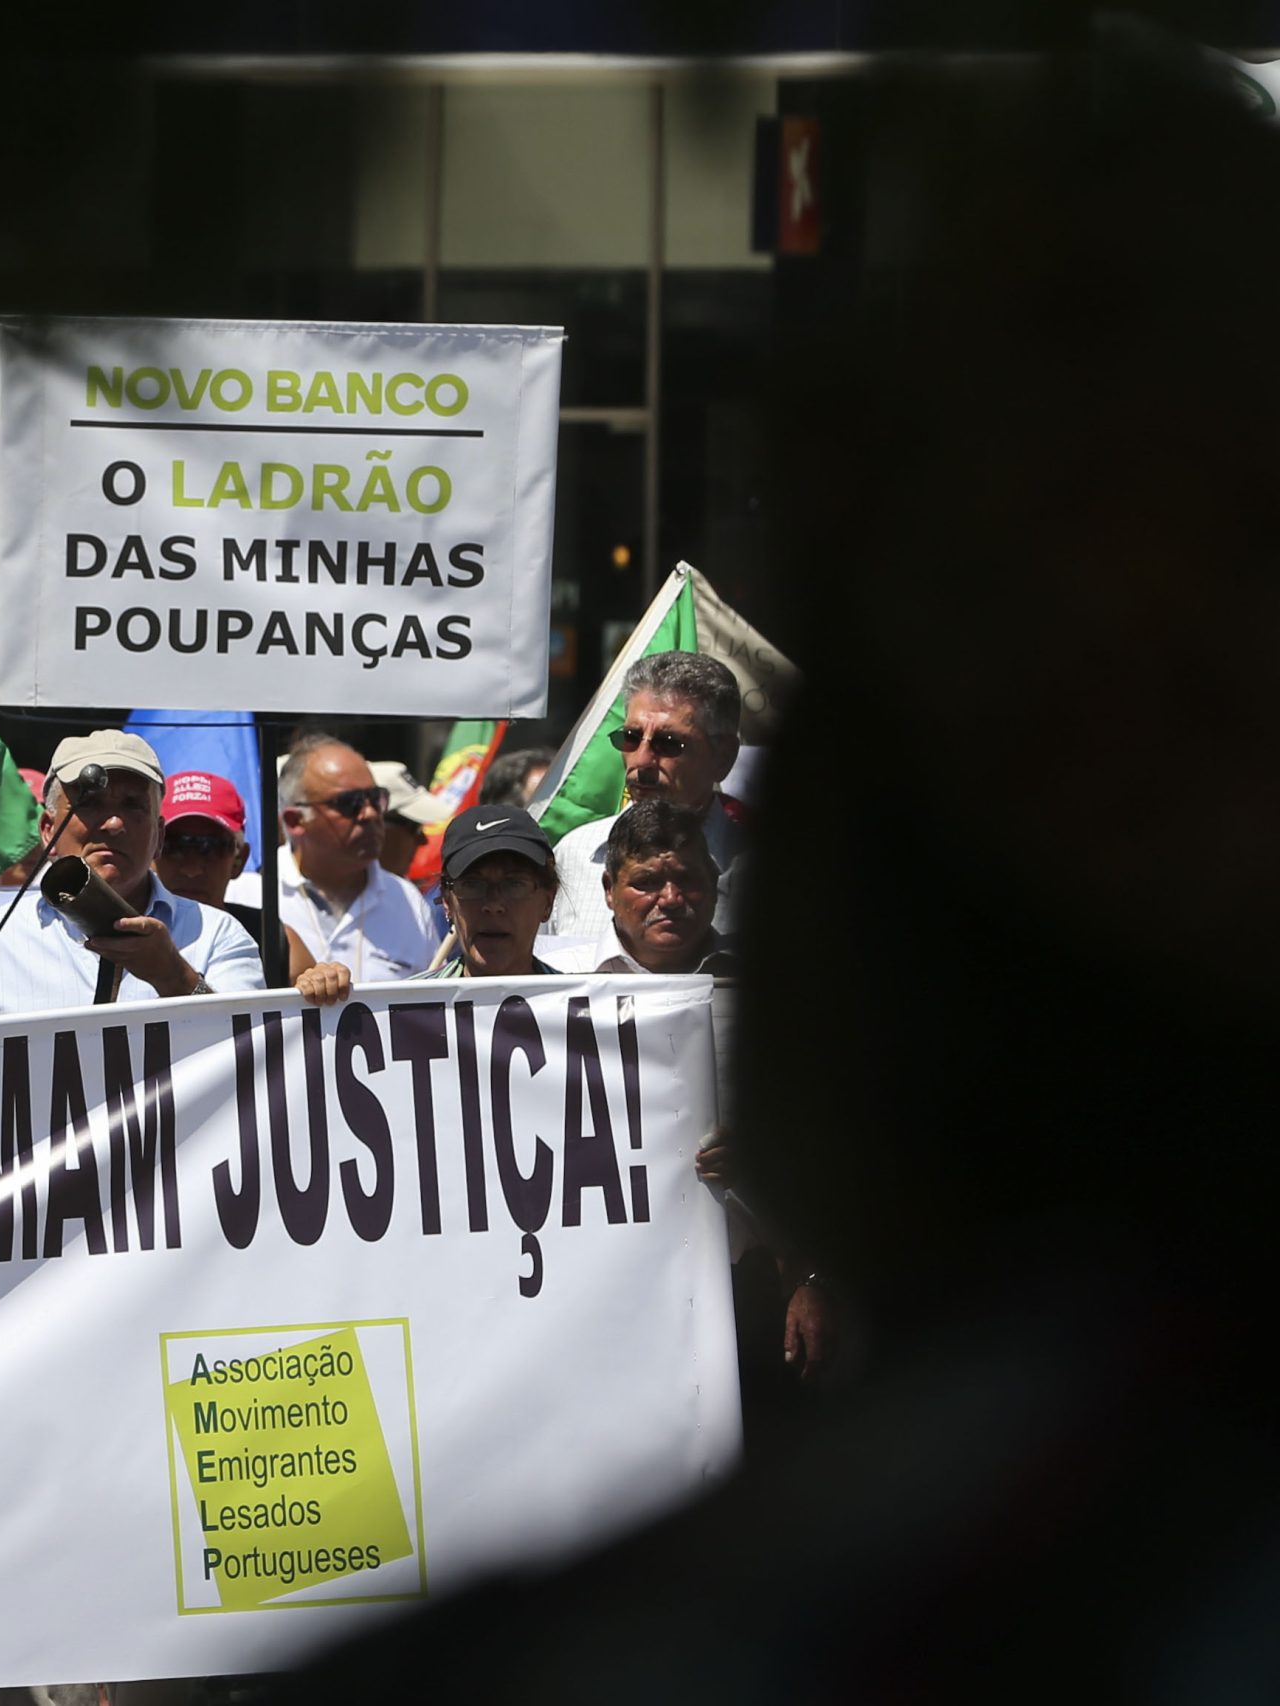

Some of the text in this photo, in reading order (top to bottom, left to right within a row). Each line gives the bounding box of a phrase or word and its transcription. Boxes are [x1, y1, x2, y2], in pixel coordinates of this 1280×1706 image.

[85, 365, 470, 417] NOVO BANCO
[101, 449, 453, 514] O LADRÃO
[65, 533, 485, 588] DAS MINHAS
[74, 606, 473, 669] POUPANÇAS
[212, 994, 652, 1299] JUSTIÇA!
[190, 1344, 354, 1386] Associação
[193, 1395, 348, 1434] Movimento
[197, 1444, 357, 1489] Emigrantes
[200, 1494, 322, 1532] Lesados
[203, 1543, 381, 1584] Portugueses
